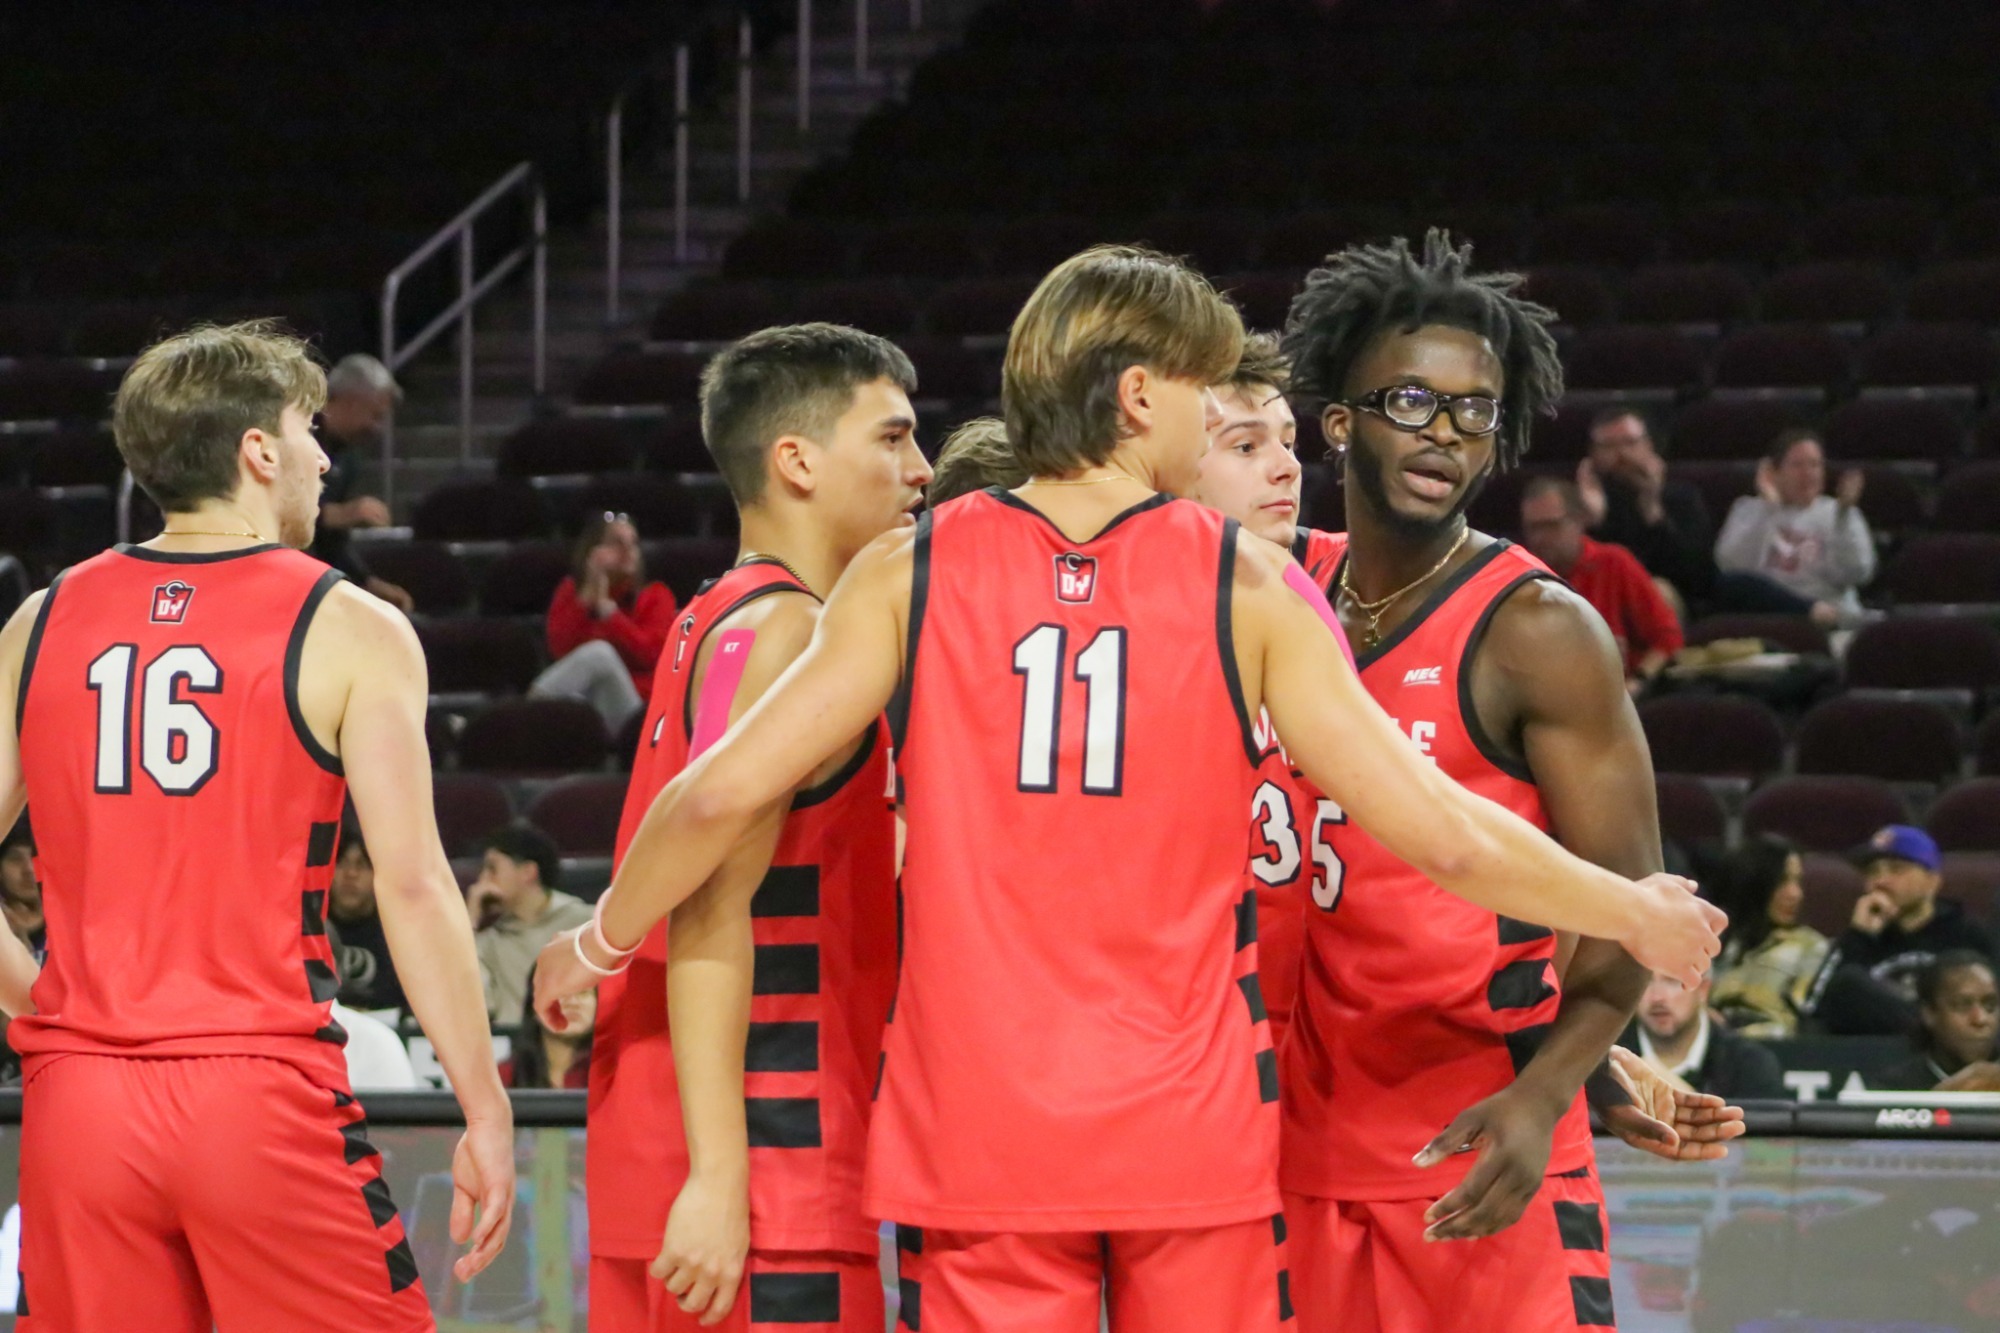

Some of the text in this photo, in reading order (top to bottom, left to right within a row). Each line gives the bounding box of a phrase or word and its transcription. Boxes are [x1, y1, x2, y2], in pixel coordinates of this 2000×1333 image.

[723, 642, 740, 653] KT
[1403, 665, 1442, 684] NEC
[86, 642, 224, 796] 16
[1012, 622, 1127, 797] 11
[1875, 1108, 1933, 1128] ARCO
